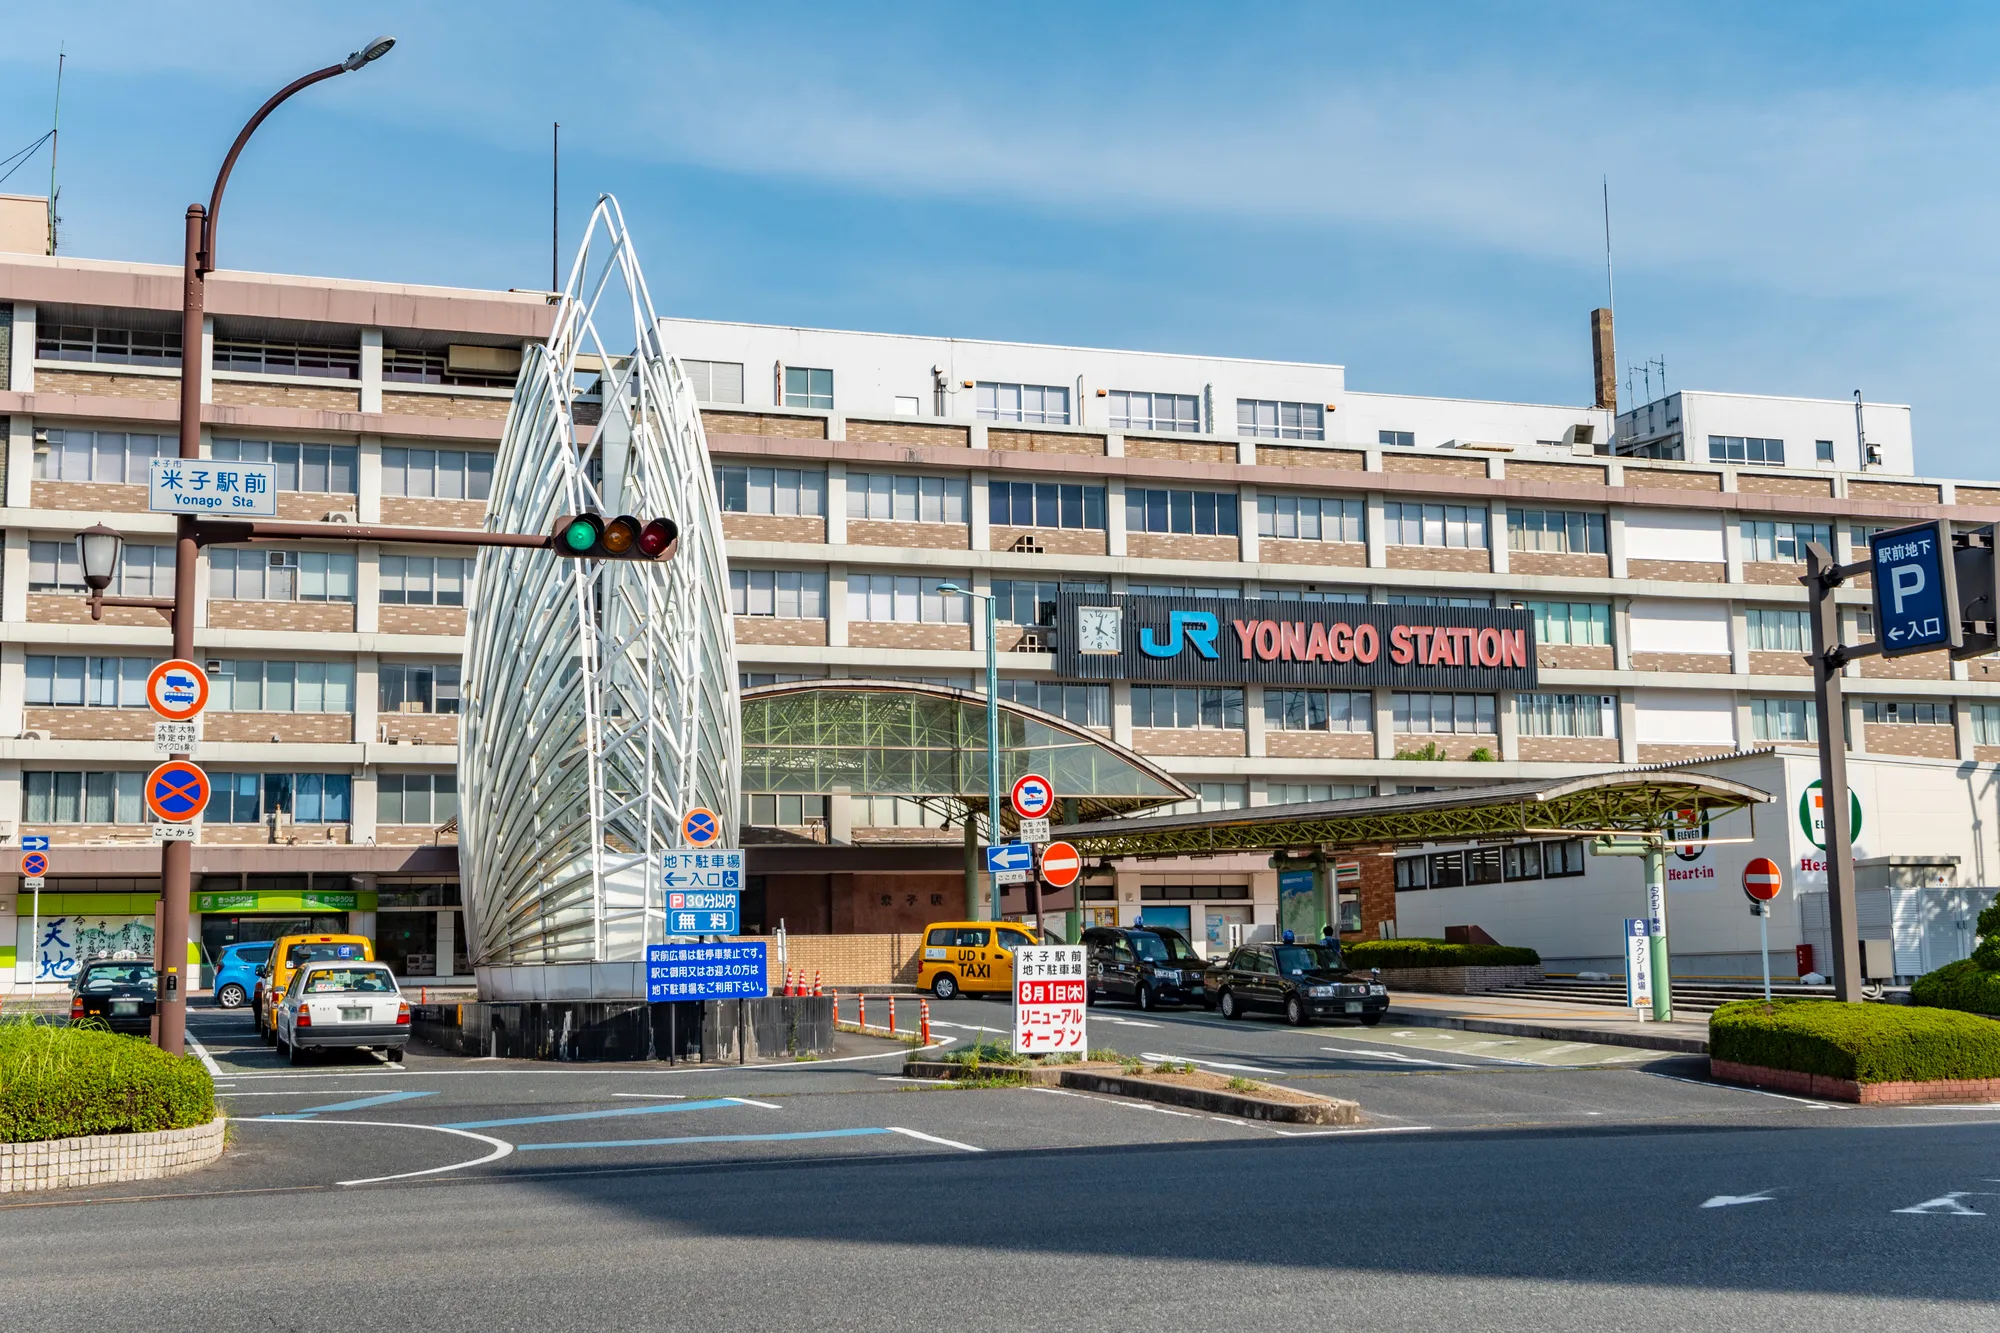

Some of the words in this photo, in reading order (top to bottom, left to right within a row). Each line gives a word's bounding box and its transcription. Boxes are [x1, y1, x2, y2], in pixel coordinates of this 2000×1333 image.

[151, 460, 182, 469] 米子市
[161, 469, 266, 493] 米子駅前
[174, 493, 222, 508] Yonago
[232, 496, 256, 508] Sta.
[1878, 539, 1931, 564] 駅前地下
[1891, 563, 1926, 614] P
[1907, 617, 1941, 640] 入口
[1140, 611, 1220, 658] JR
[1233, 619, 1379, 664] YONAGO
[1390, 624, 1527, 668] STATION
[158, 733, 196, 742] 特定中型
[155, 828, 195, 837] ここから
[664, 855, 740, 868] 地下駐車場
[690, 872, 720, 886] 入口
[998, 873, 1023, 881] ここから
[686, 893, 736, 909] 30分以内
[1651, 886, 1661, 933] タクシー乗場
[678, 912, 727, 930] 無料
[651, 948, 763, 962] 駅前広場は駐停車禁止です。
[958, 950, 976, 961] UD
[1022, 951, 1082, 962] 米子駅前
[958, 963, 991, 978] TAXI
[1022, 964, 1082, 975] 地下駐車場
[1636, 938, 1646, 990] タクシー乗場
[651, 965, 759, 979] 駅に御用又はお迎えの方は
[652, 981, 764, 996] 地下駐車場をご利用下さい。
[1021, 983, 1084, 1002] 8月1日(木)
[1021, 1009, 1082, 1025] リニューアル
[1021, 1028, 1082, 1048] オープン
